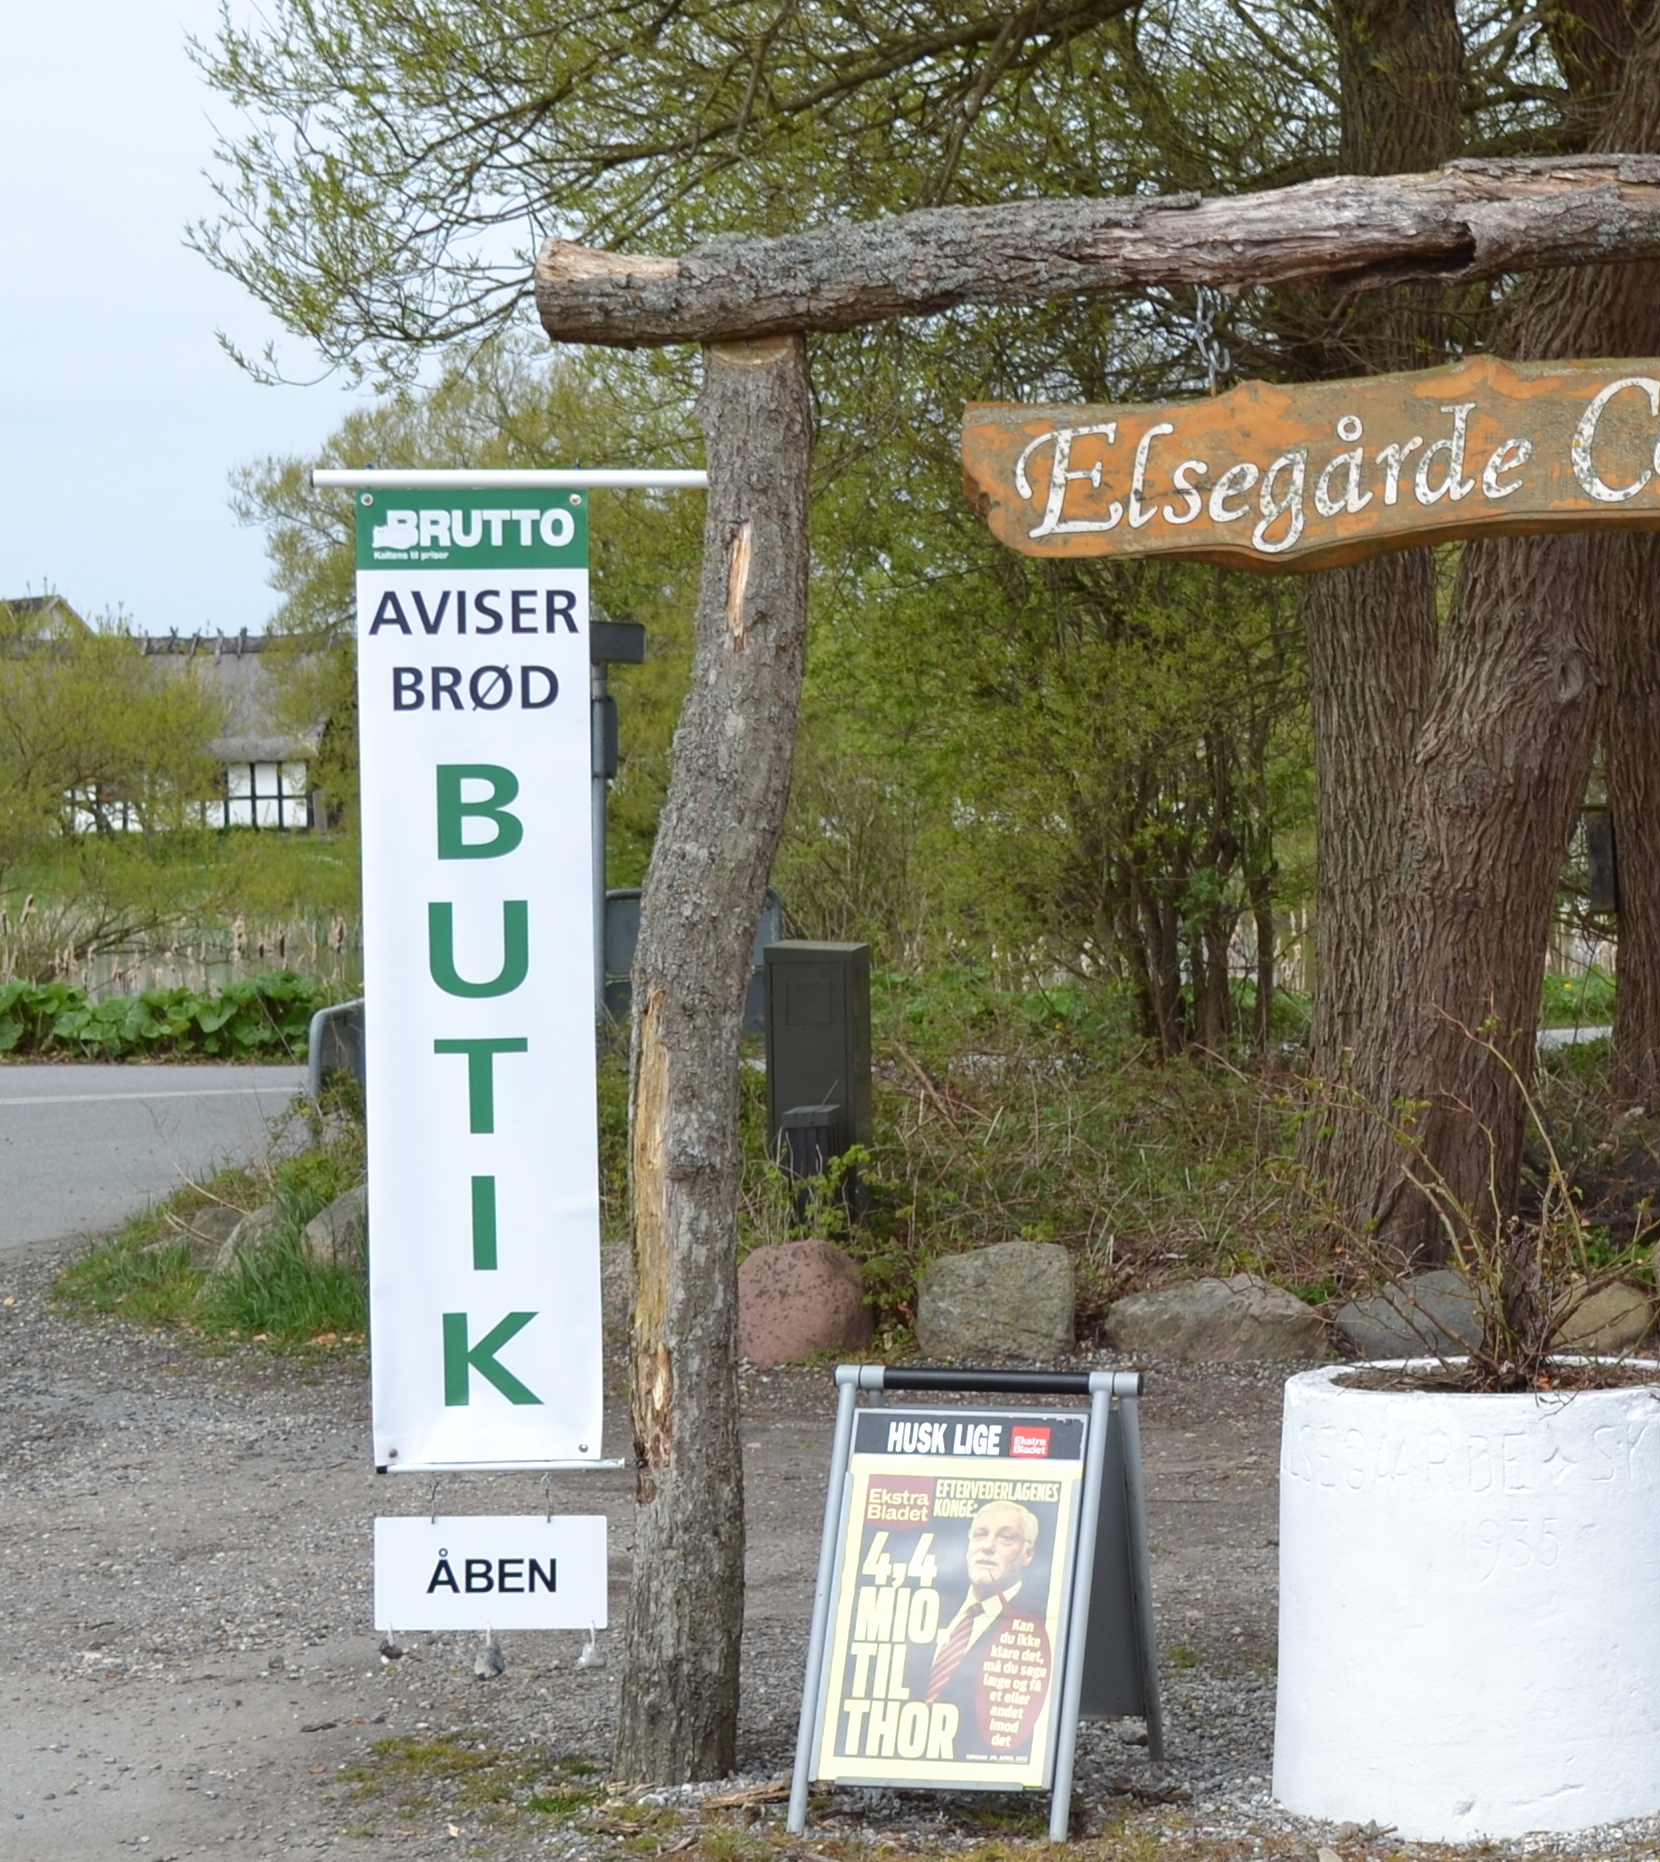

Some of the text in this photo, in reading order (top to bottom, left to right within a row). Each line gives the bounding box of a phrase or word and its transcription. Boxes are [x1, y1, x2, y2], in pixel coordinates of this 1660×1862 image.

[1015, 403, 1532, 552] Elsegårde
[372, 508, 575, 549] BRUTTO
[368, 589, 579, 635] AVISER
[392, 663, 559, 712] BRØD
[427, 762, 545, 1408] BUTIK
[887, 1421, 1002, 1456] HUSK LIGE
[1014, 1436, 1047, 1446] Ekstra
[1013, 1445, 1046, 1455] Bladet
[868, 1488, 929, 1507] Ekstra
[935, 1479, 1060, 1502] EFTERVEDERLAGENES
[866, 1503, 928, 1522] Bladet
[933, 1498, 979, 1519] KONGE:
[862, 1531, 938, 1588] 4,4
[426, 1548, 557, 1593] ÅBEN
[854, 1586, 950, 1644] MIO.
[1011, 1619, 1035, 1633] Kan
[1000, 1632, 1041, 1648] du ikke
[990, 1645, 1045, 1665] klare det,
[850, 1642, 910, 1700] TIL
[983, 1660, 1048, 1679] må du søge
[1012, 1678, 1028, 1693] og
[989, 1690, 1031, 1705] et eller
[989, 1705, 1024, 1719] andet
[843, 1699, 960, 1760] THOR
[989, 1718, 1020, 1734] imod
[990, 1733, 1012, 1748] det
